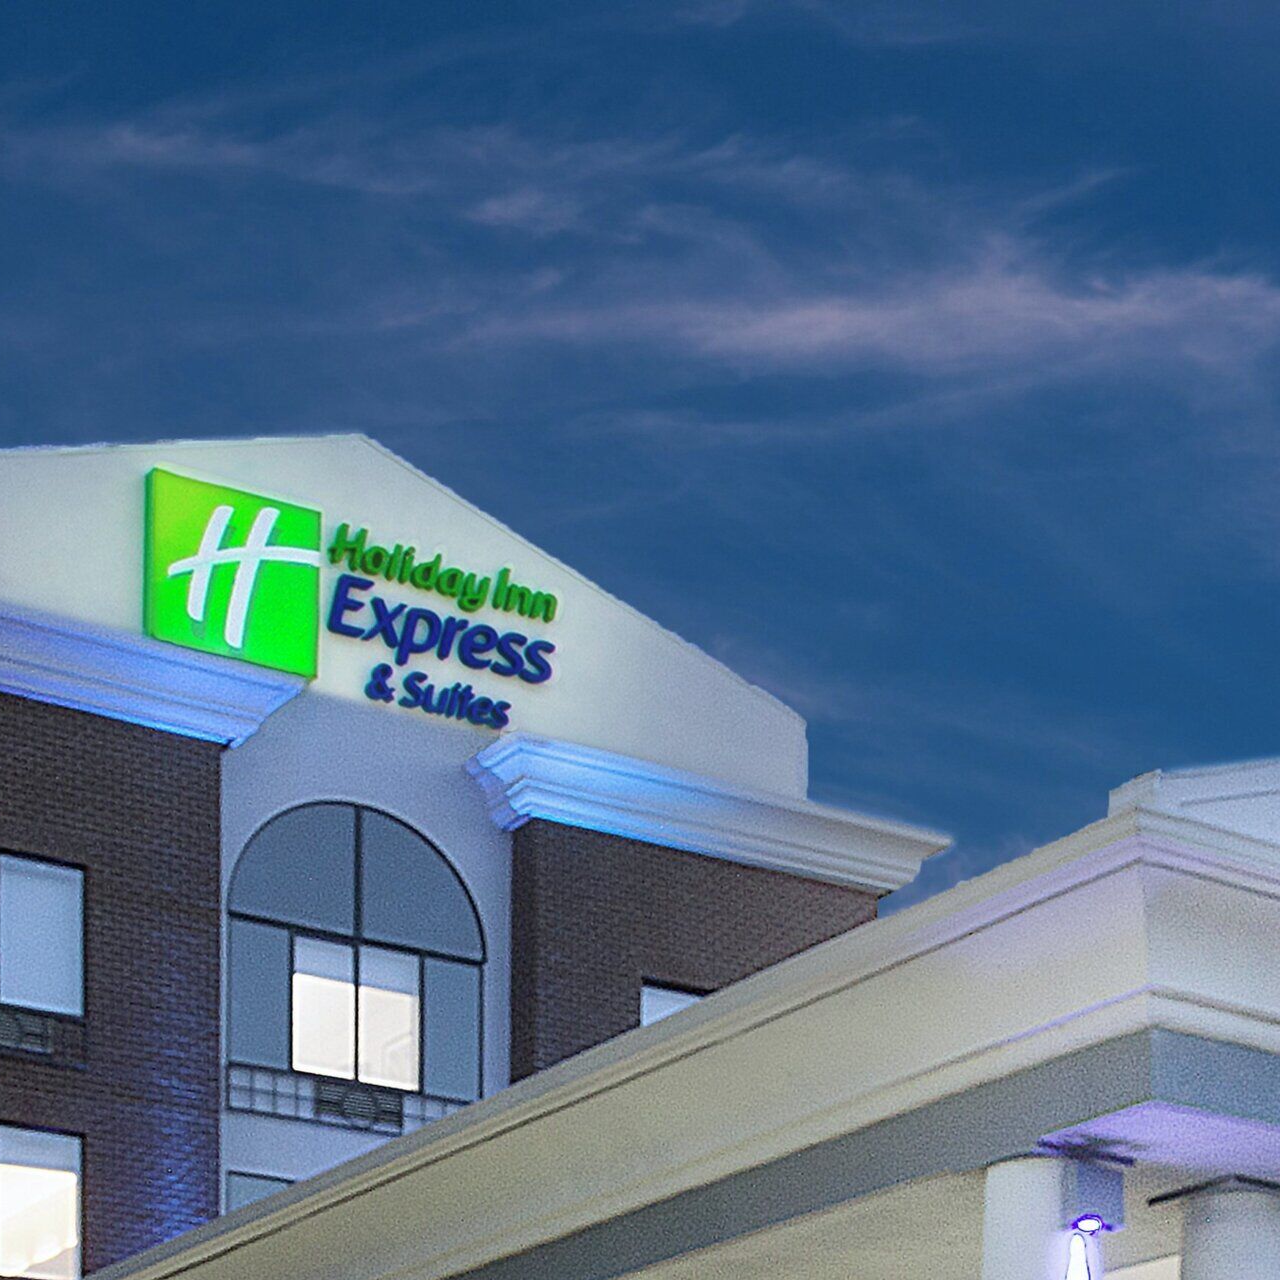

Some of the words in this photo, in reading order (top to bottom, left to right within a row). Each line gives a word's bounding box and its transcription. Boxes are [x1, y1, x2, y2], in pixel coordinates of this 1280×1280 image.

[167, 505, 321, 649] H
[327, 523, 491, 612] Holiday
[491, 567, 558, 623] Inn
[327, 573, 556, 684] Express
[364, 663, 395, 703] &
[398, 671, 511, 729] Suites
